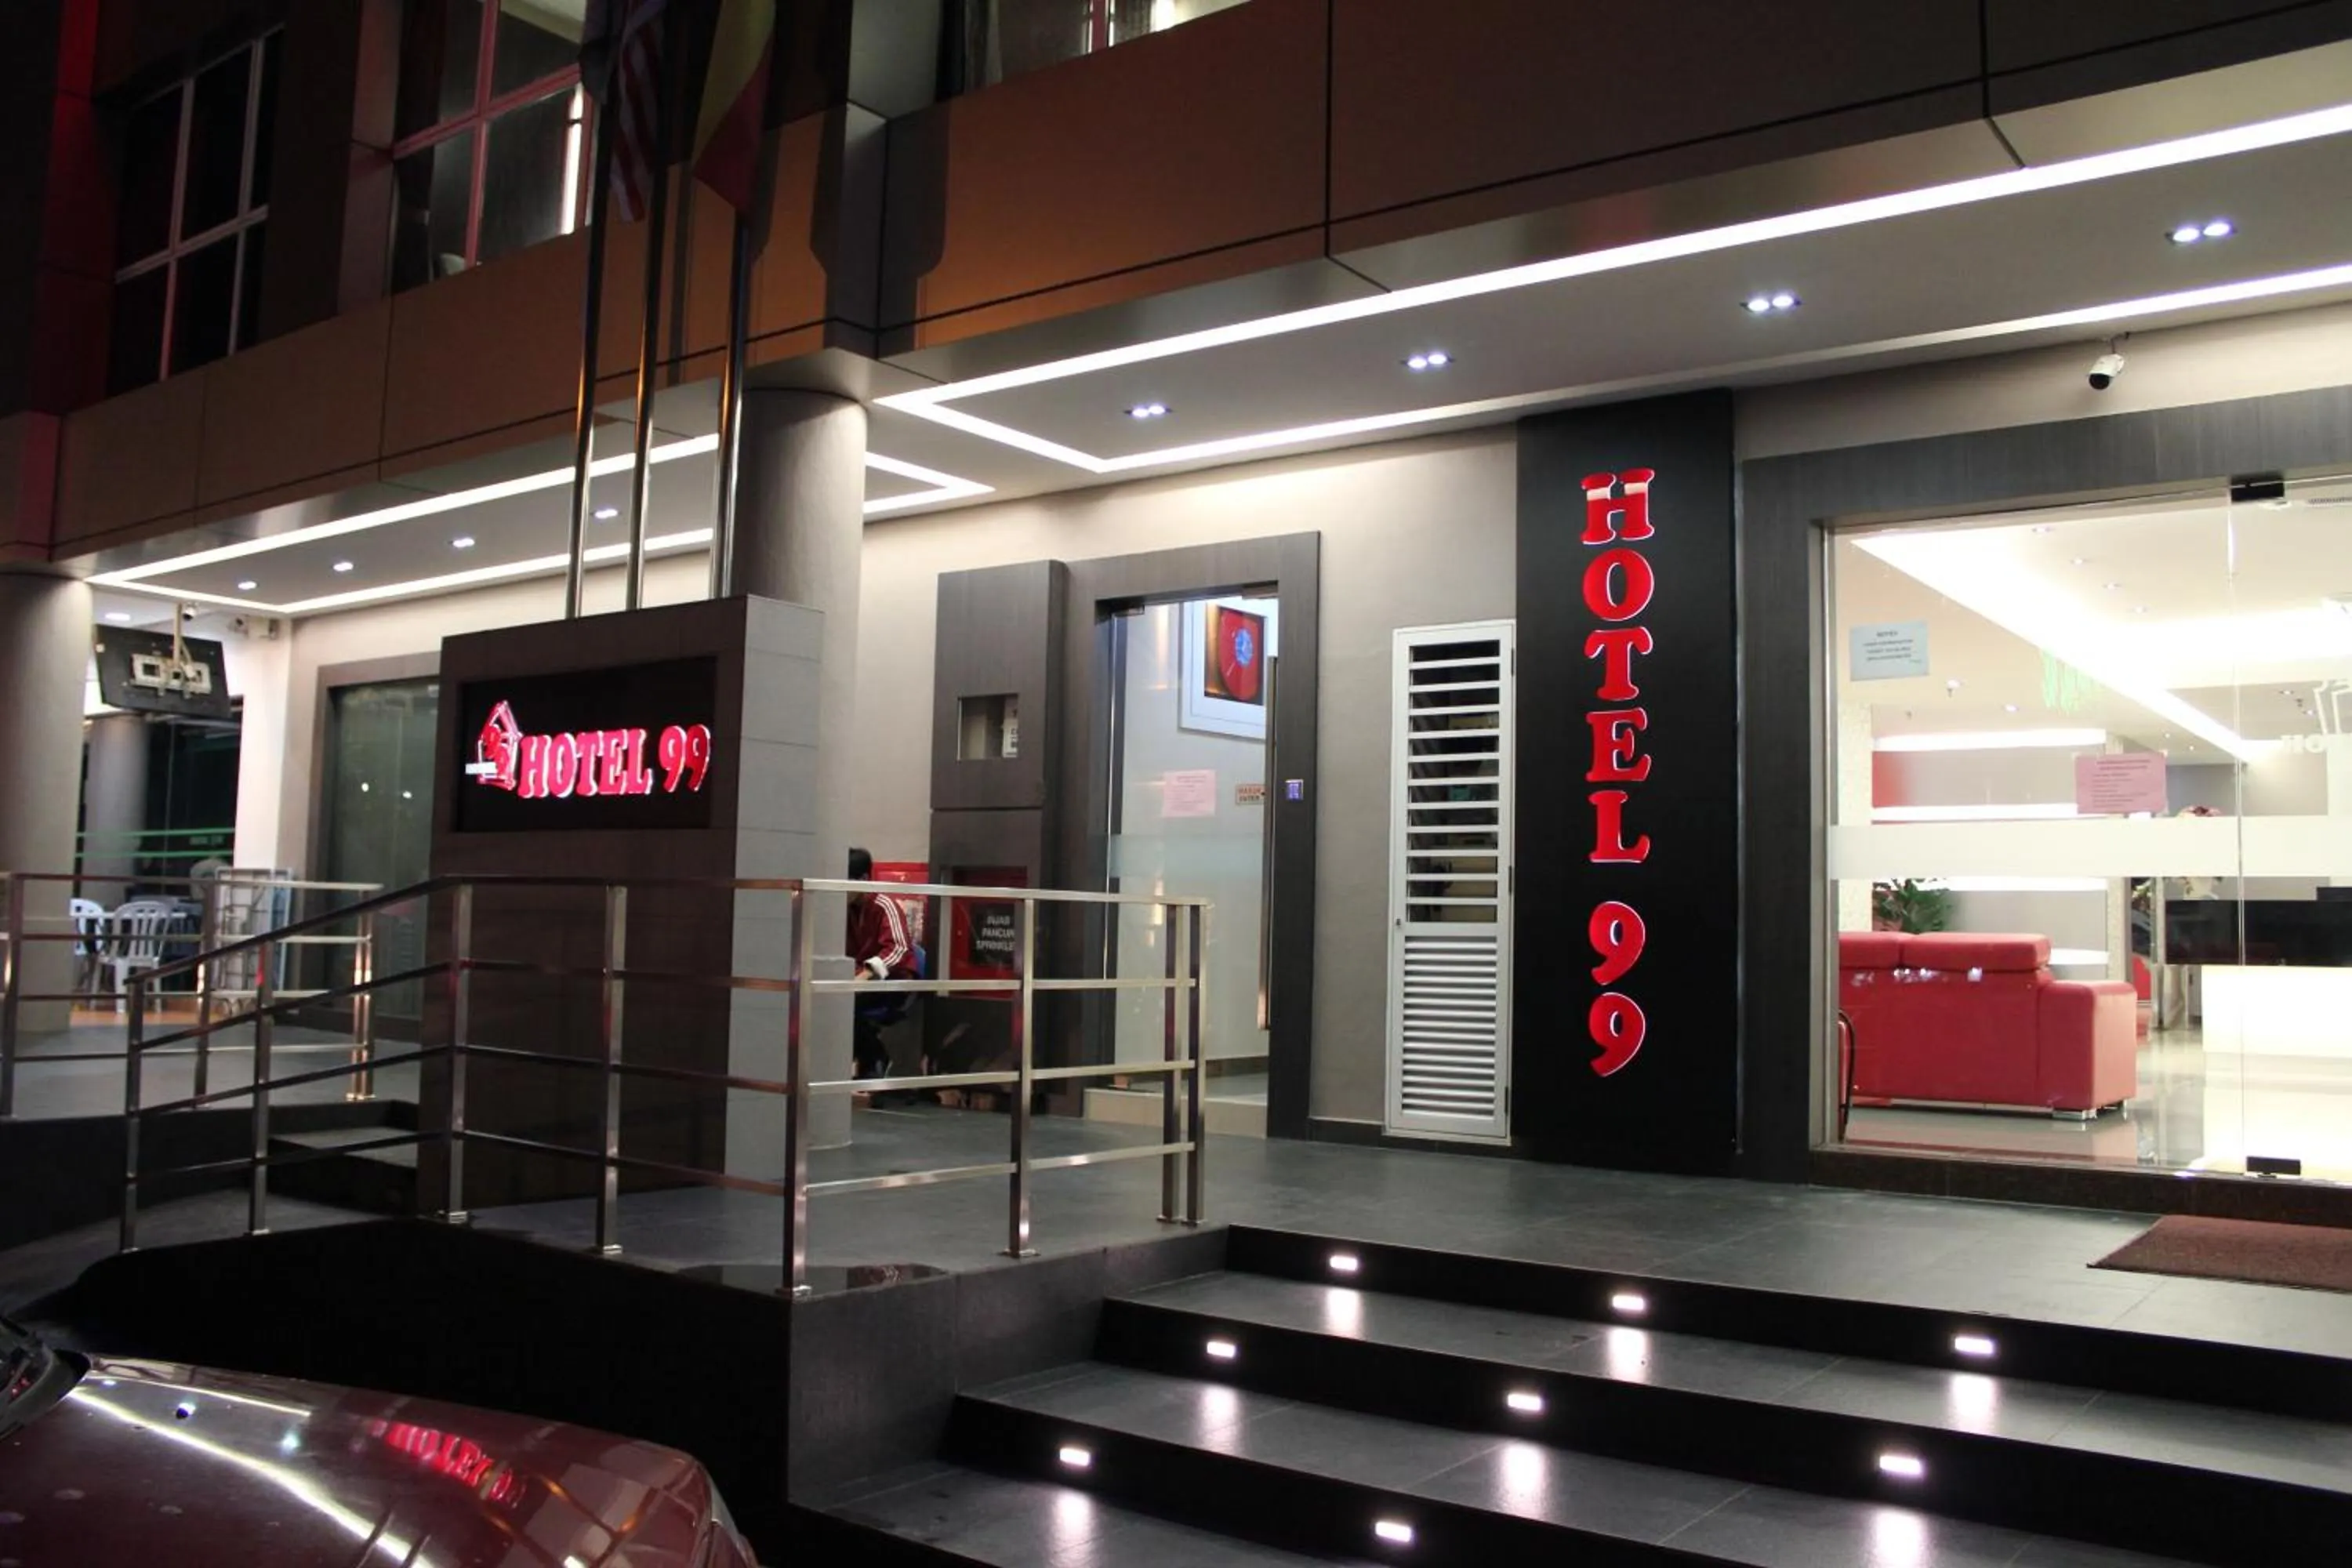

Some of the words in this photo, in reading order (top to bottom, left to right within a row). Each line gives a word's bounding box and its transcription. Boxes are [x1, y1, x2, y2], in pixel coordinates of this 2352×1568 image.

[1580, 468, 1656, 863] HOTEL
[517, 728, 653, 798] HOTEL
[659, 724, 710, 793] 99
[975, 941, 1014, 951] SPRINKLE
[1588, 901, 1646, 1077] 99
